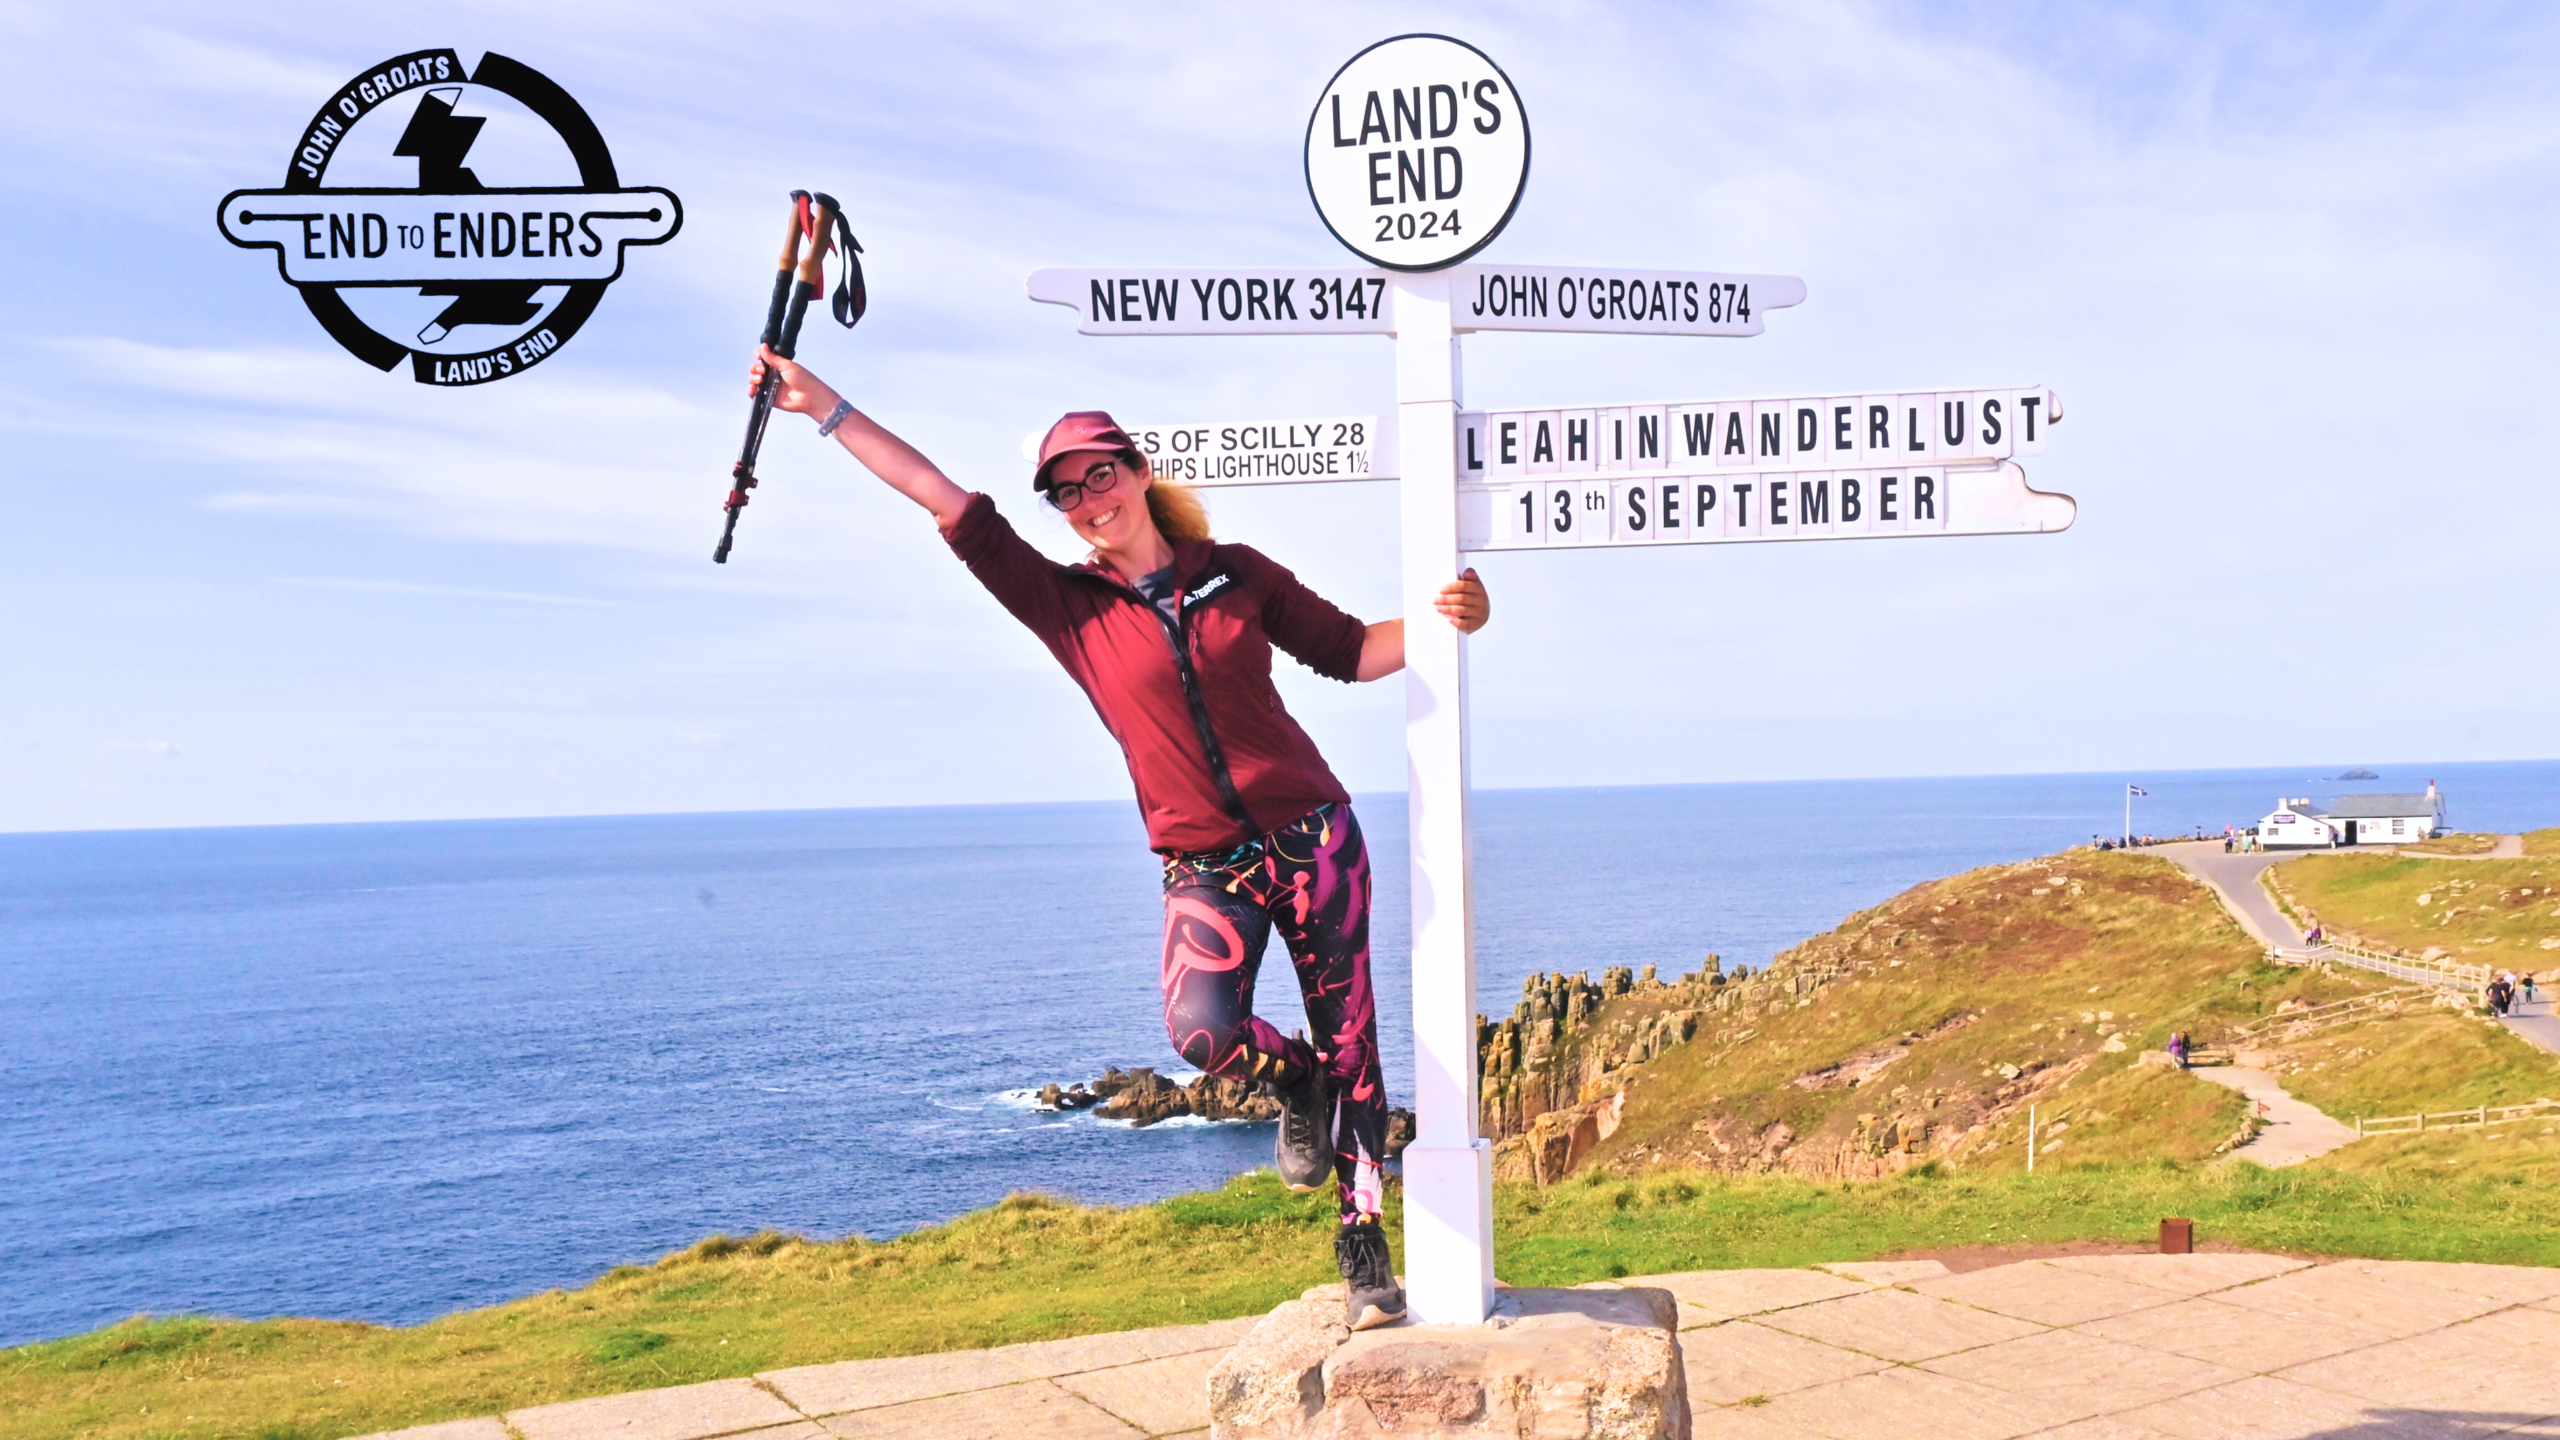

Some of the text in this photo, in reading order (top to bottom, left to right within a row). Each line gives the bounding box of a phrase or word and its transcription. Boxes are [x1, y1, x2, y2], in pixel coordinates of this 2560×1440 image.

[1332, 78, 1501, 148] LAND'S
[1369, 146, 1463, 206] END
[1374, 209, 1462, 242] 2024
[1091, 278, 1386, 322] NEW YORK 3147
[1472, 275, 1750, 324] JOHN O'GROATS 874
[1171, 429, 1210, 453] OF
[1221, 424, 1323, 451] SCILLY
[1333, 423, 1365, 446] 28
[1466, 396, 2041, 471] LEAH IN WANDERLUST
[1204, 452, 1338, 479] LIGHTHOUSE
[1627, 475, 1936, 531] SEPTEMBER
[1192, 574, 1230, 600] TERREX
